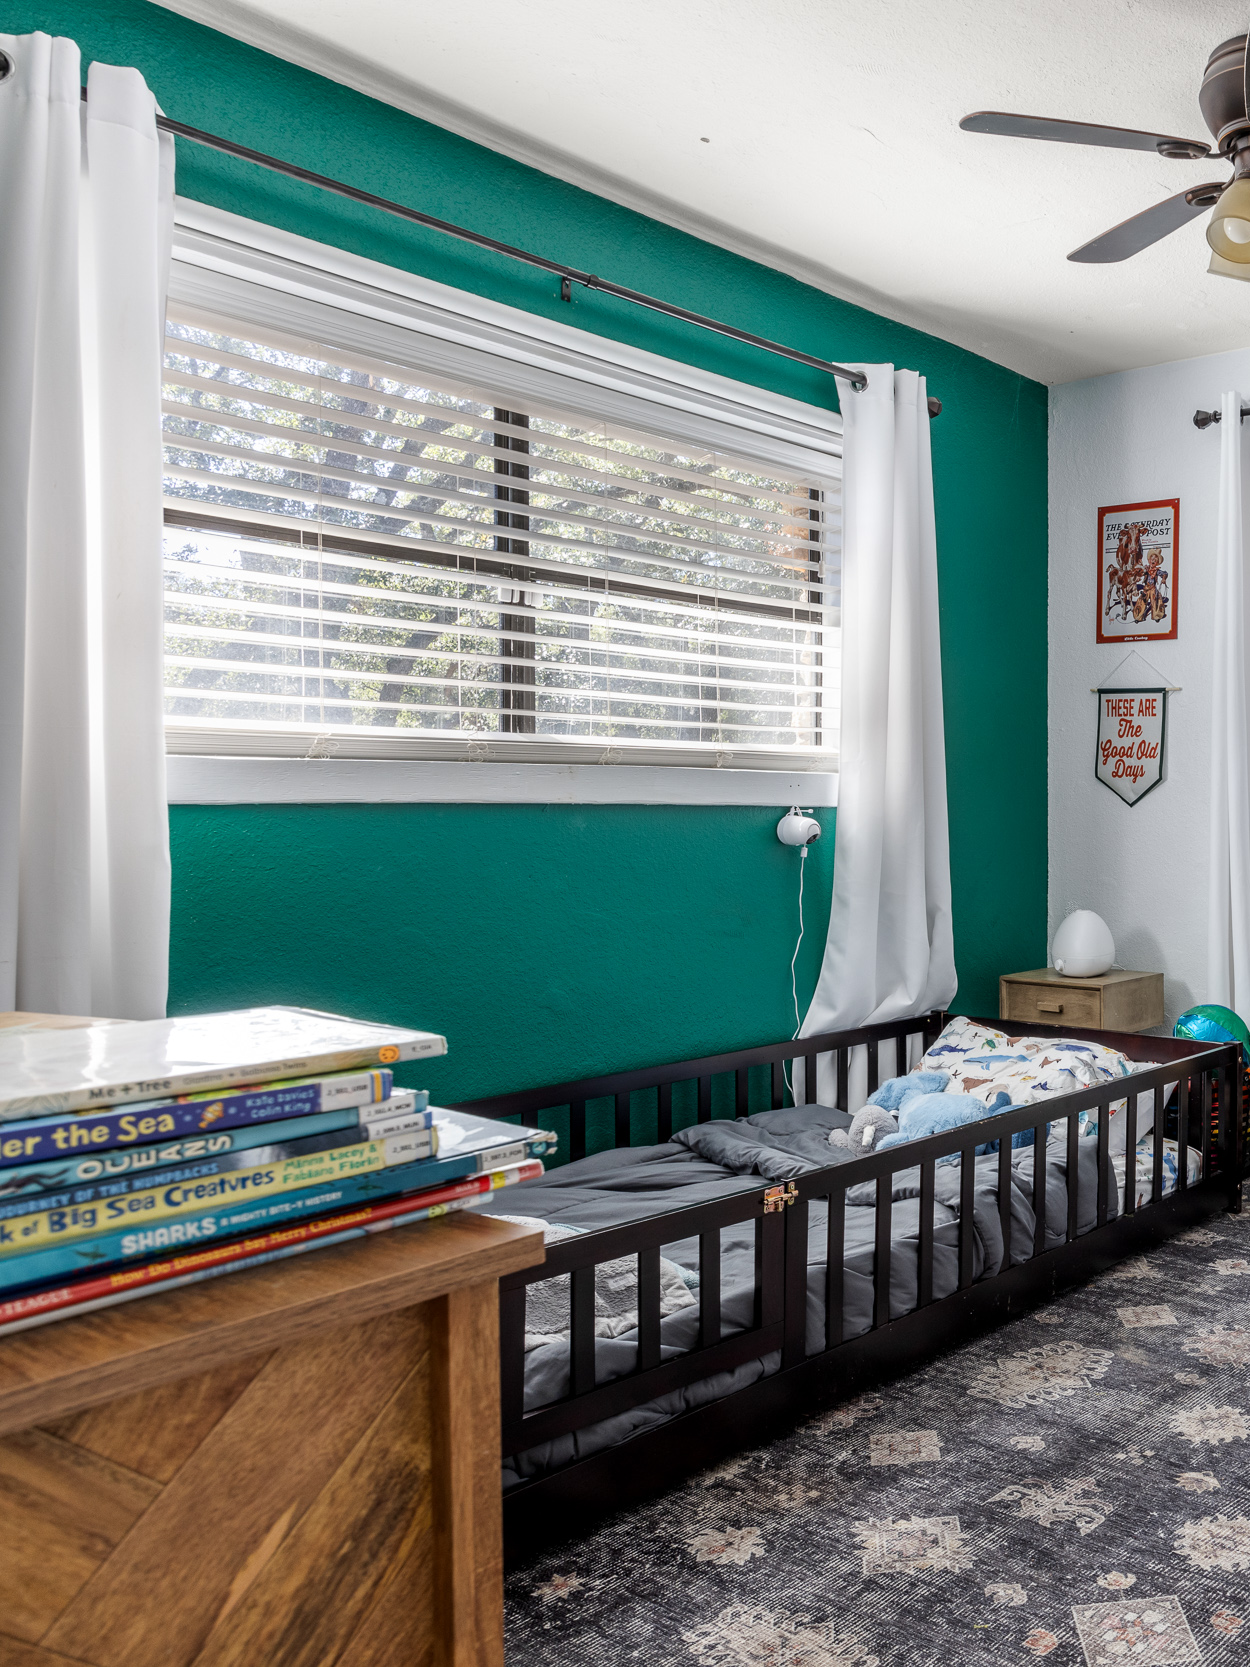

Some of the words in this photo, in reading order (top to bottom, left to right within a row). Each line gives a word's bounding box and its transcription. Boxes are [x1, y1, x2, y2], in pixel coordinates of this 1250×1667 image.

[1105, 523, 1123, 532] THE
[1146, 527, 1172, 537] POST
[1105, 698, 1135, 717] THESE
[1137, 698, 1157, 717] ARE
[1117, 718, 1143, 739] The
[1100, 739, 1135, 766] Good
[1136, 739, 1159, 760] Old
[1111, 759, 1146, 784] Days
[88, 1087, 116, 1100] Me
[137, 1078, 172, 1094] Tree
[246, 1092, 275, 1109] Kate
[277, 1088, 315, 1103] Davies
[250, 1106, 283, 1119] Colin
[284, 1101, 312, 1116] King
[51, 1123, 110, 1150] the
[116, 1113, 175, 1142] Sea
[76, 1134, 232, 1180] OCEANS
[329, 1145, 367, 1161] Lacey
[74, 1187, 95, 1202] OF
[98, 1180, 130, 1197] THE
[132, 1162, 220, 1192] HUMPBACKS
[282, 1166, 335, 1184] Fabiano
[21, 1219, 41, 1237] of
[48, 1207, 97, 1233] Big
[106, 1196, 157, 1219] Sea
[121, 1217, 217, 1254] SHARKS
[230, 1208, 267, 1225] MIGHTY
[269, 1201, 303, 1216] BITE-Y
[305, 1191, 343, 1208] HISTORY
[5, 1288, 73, 1315] TEAGUE
[109, 1267, 146, 1288] How
[148, 1262, 171, 1278] Do
[173, 1244, 242, 1270] Dinosaurs
[269, 1225, 307, 1243] Merry
